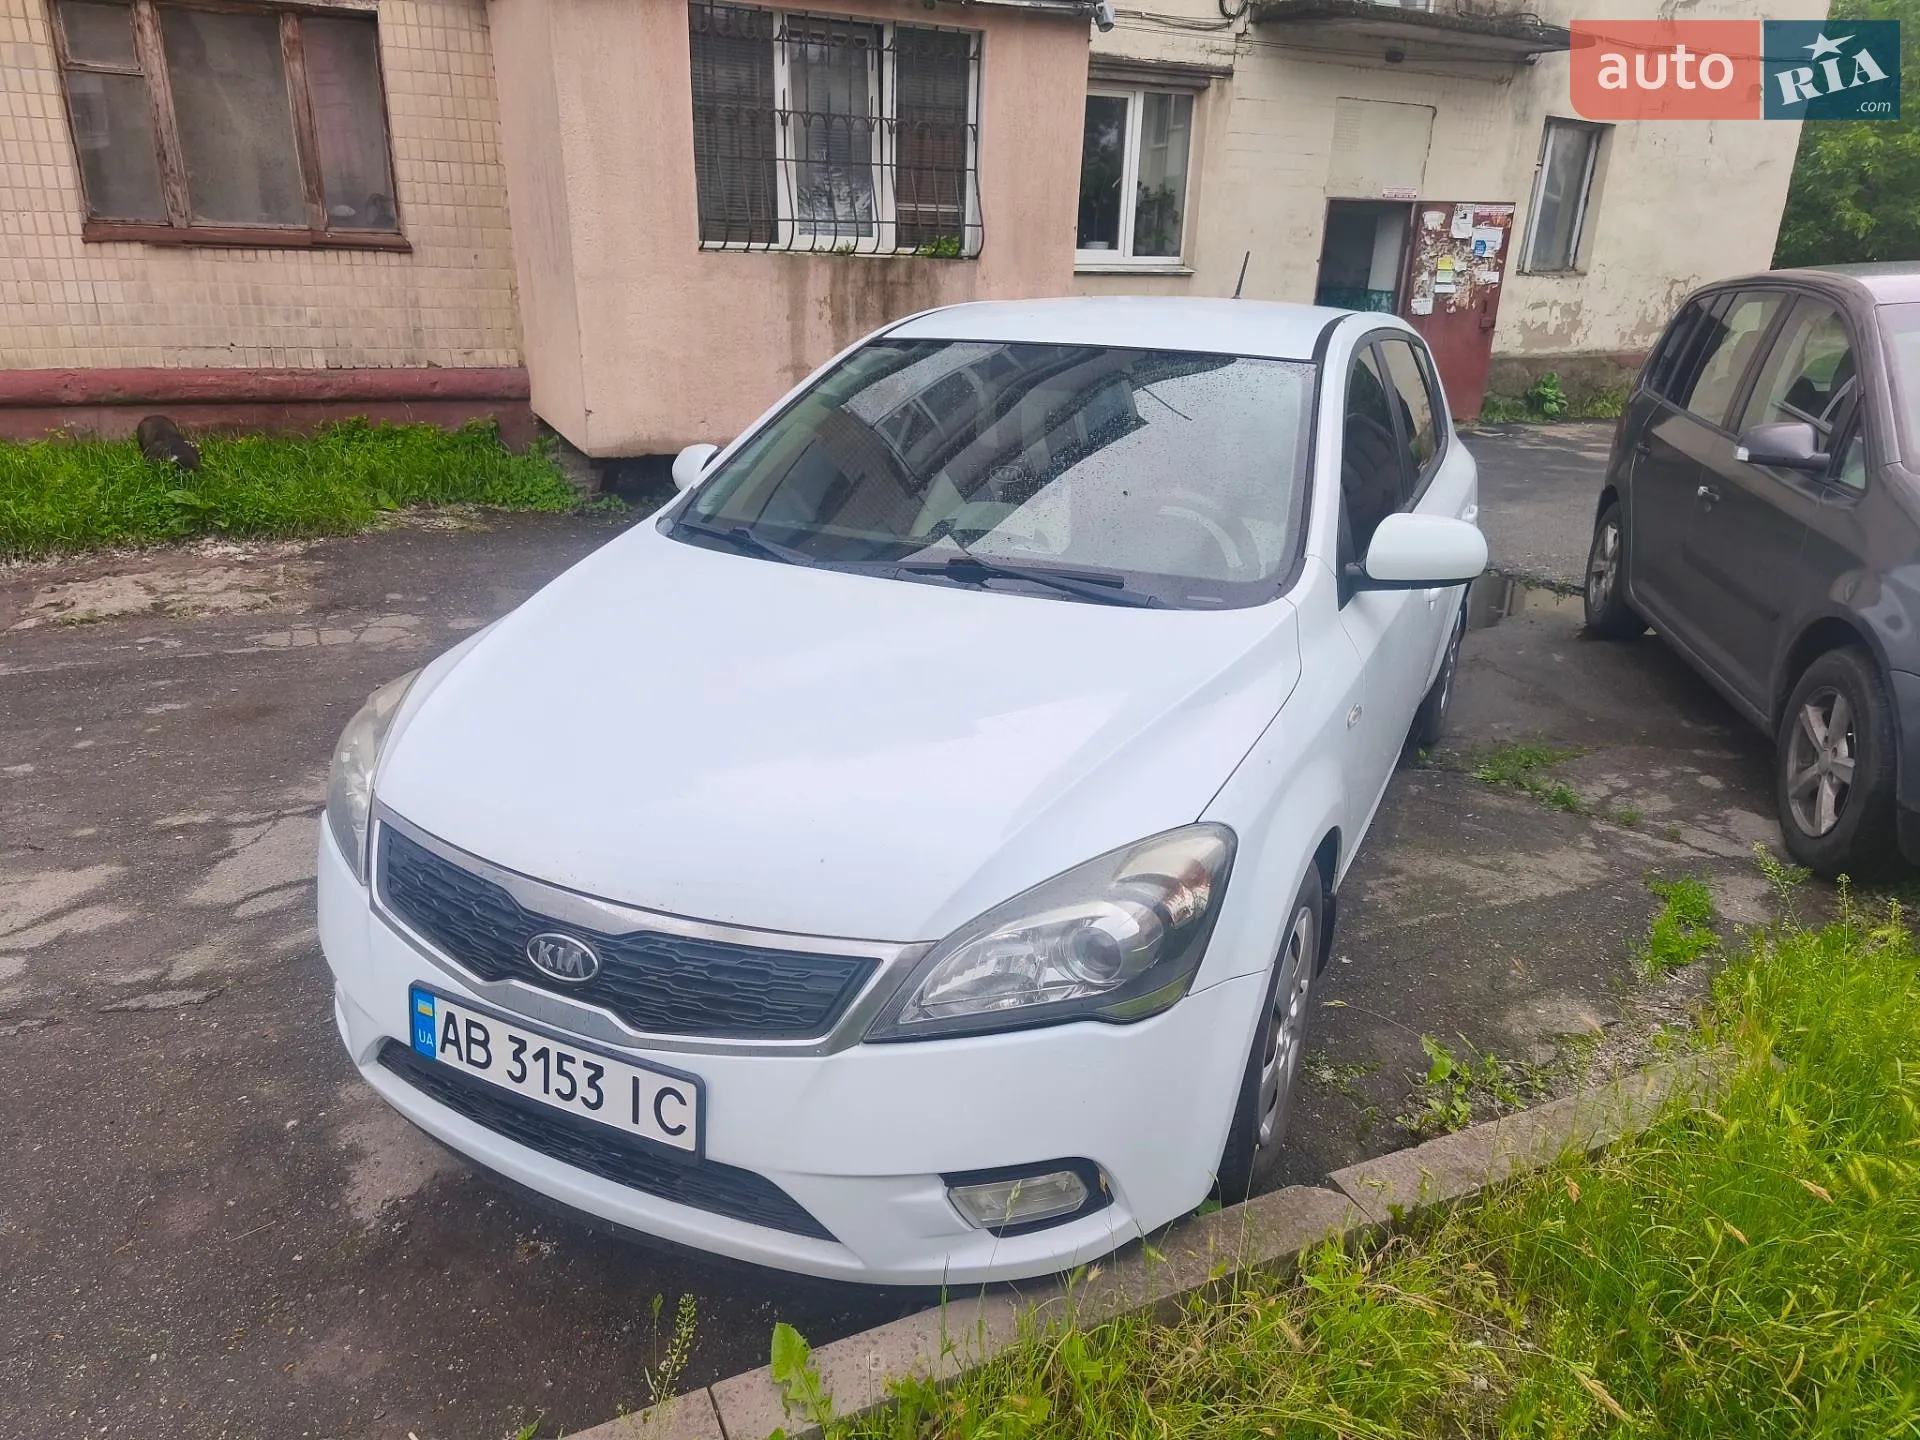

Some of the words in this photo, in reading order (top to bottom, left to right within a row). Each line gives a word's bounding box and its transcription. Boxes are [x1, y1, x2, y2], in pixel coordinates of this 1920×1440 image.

[538, 940, 585, 978] KIA
[418, 1028, 434, 1049] UA
[440, 1011, 493, 1070] AB
[506, 1034, 605, 1111] 3153
[631, 1075, 688, 1137] IC
